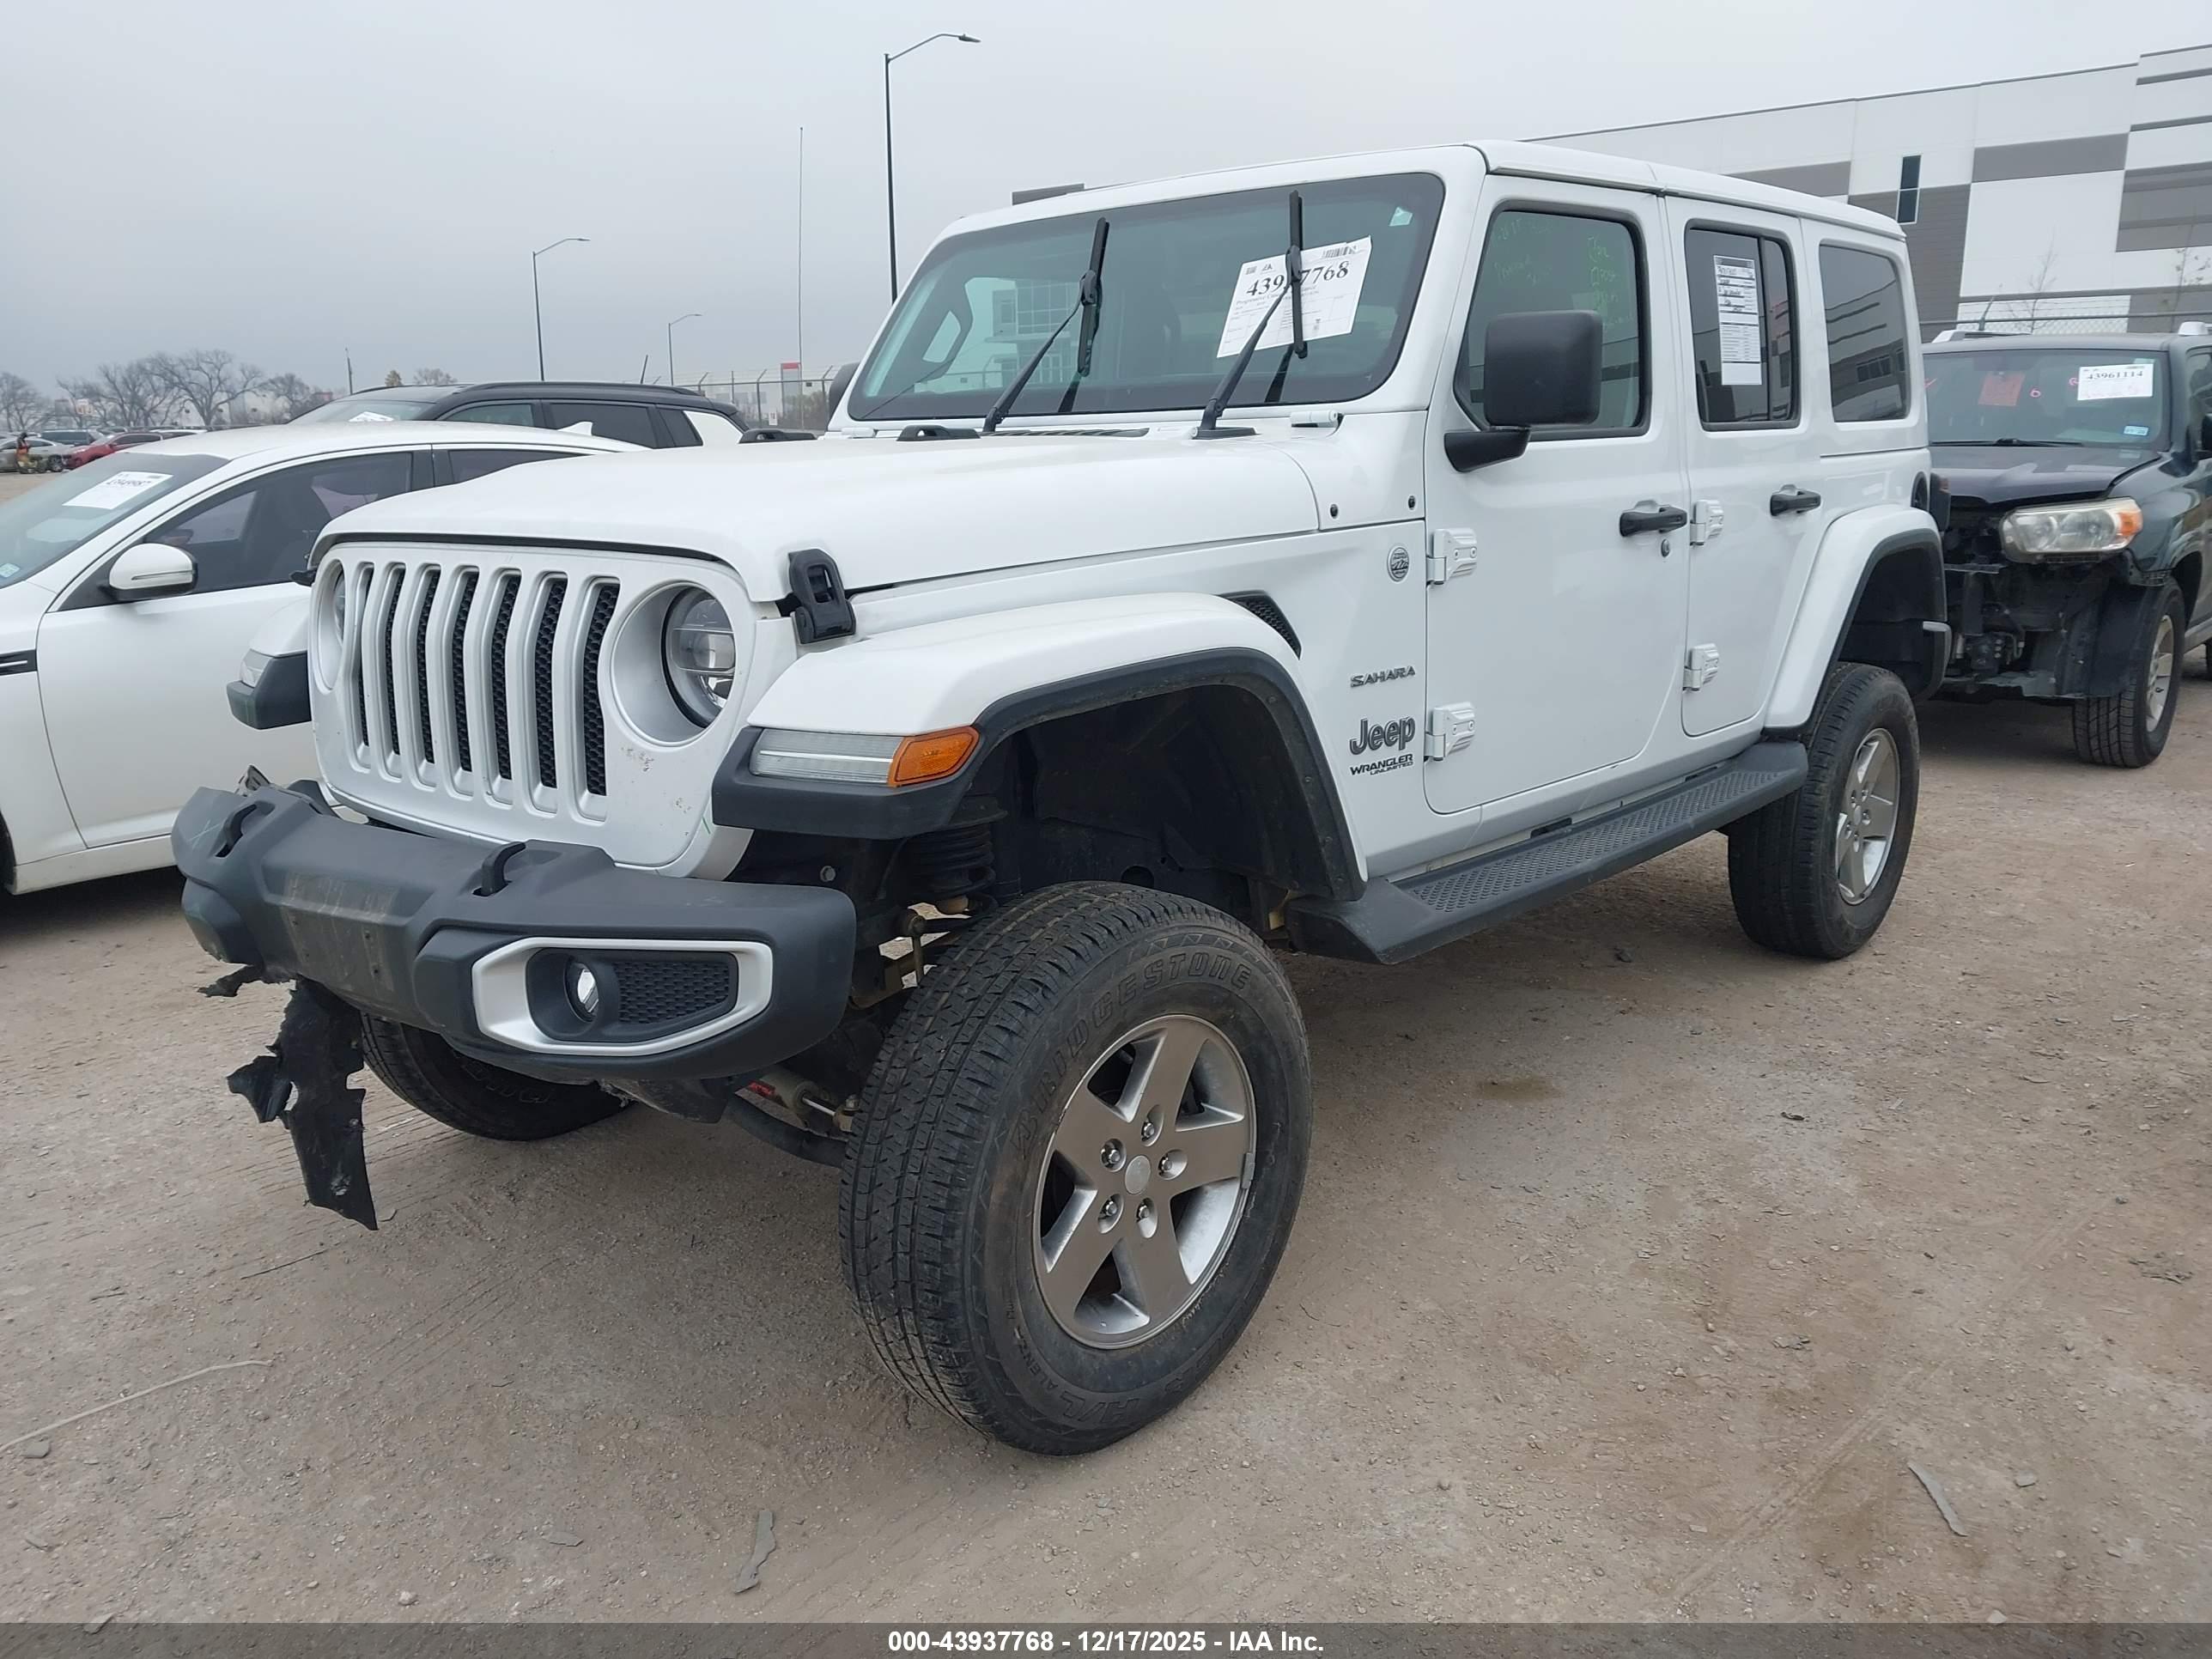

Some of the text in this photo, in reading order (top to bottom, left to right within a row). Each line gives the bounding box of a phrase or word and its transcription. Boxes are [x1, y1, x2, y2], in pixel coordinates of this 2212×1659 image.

[1246, 260, 1350, 296] 4397768
[1350, 665, 1416, 688] SAHARA
[1349, 716, 1416, 756] Jeep
[1349, 753, 1413, 775] WRANGLER
[1011, 951, 1253, 1161] BRIDGESTONE
